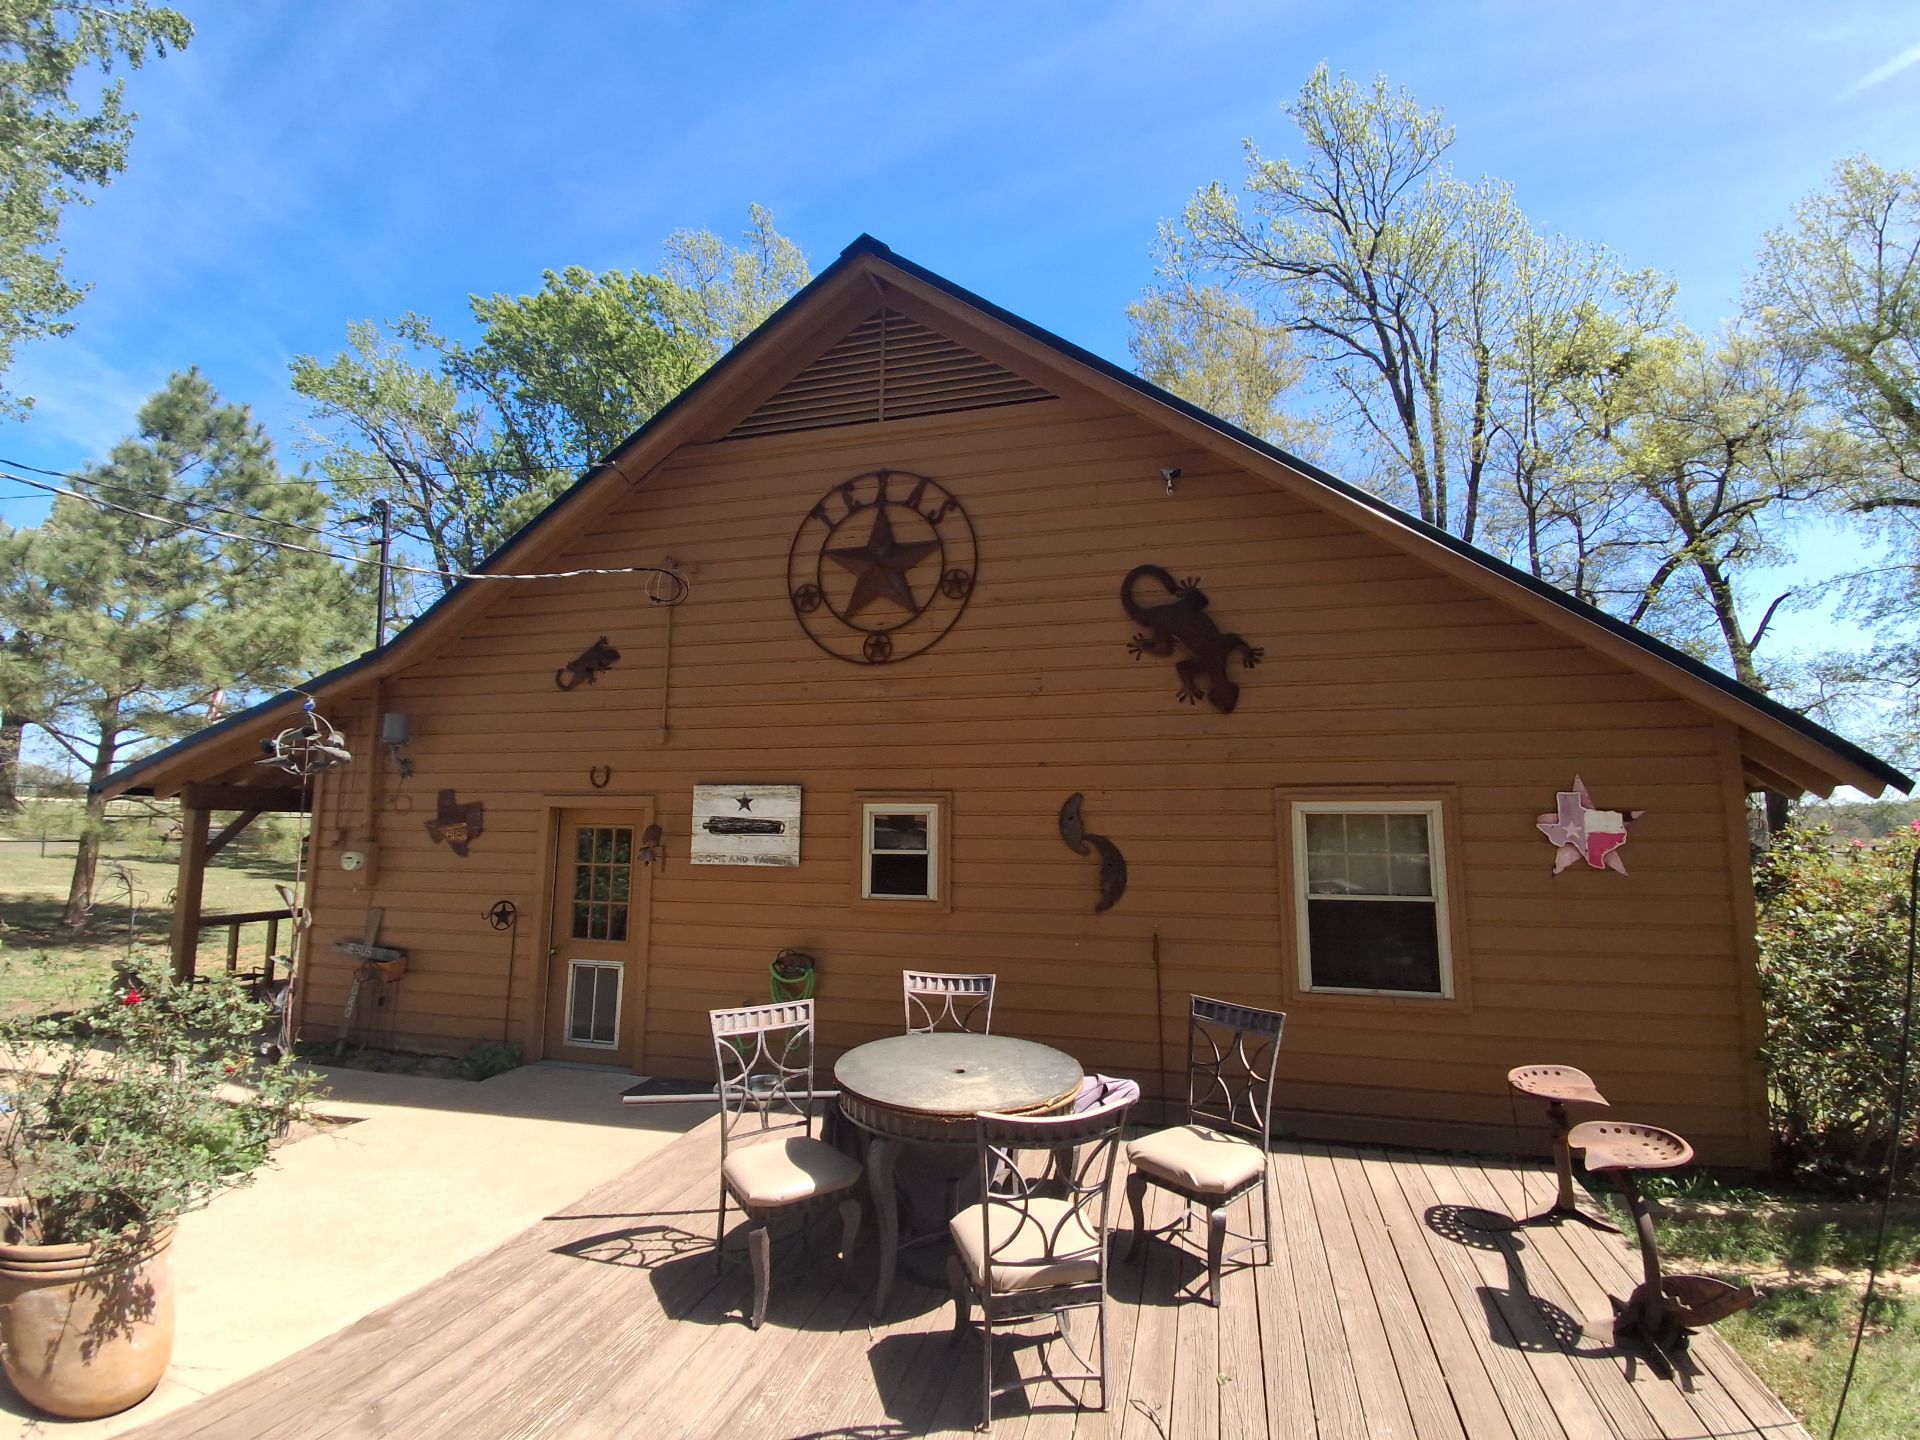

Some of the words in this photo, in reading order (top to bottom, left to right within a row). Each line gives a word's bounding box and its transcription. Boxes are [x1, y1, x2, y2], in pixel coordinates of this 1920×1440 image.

[809, 470, 958, 527] TEXAS
[697, 854, 727, 864] COME
[728, 855, 749, 864] AND
[344, 942, 373, 957] JESUS
